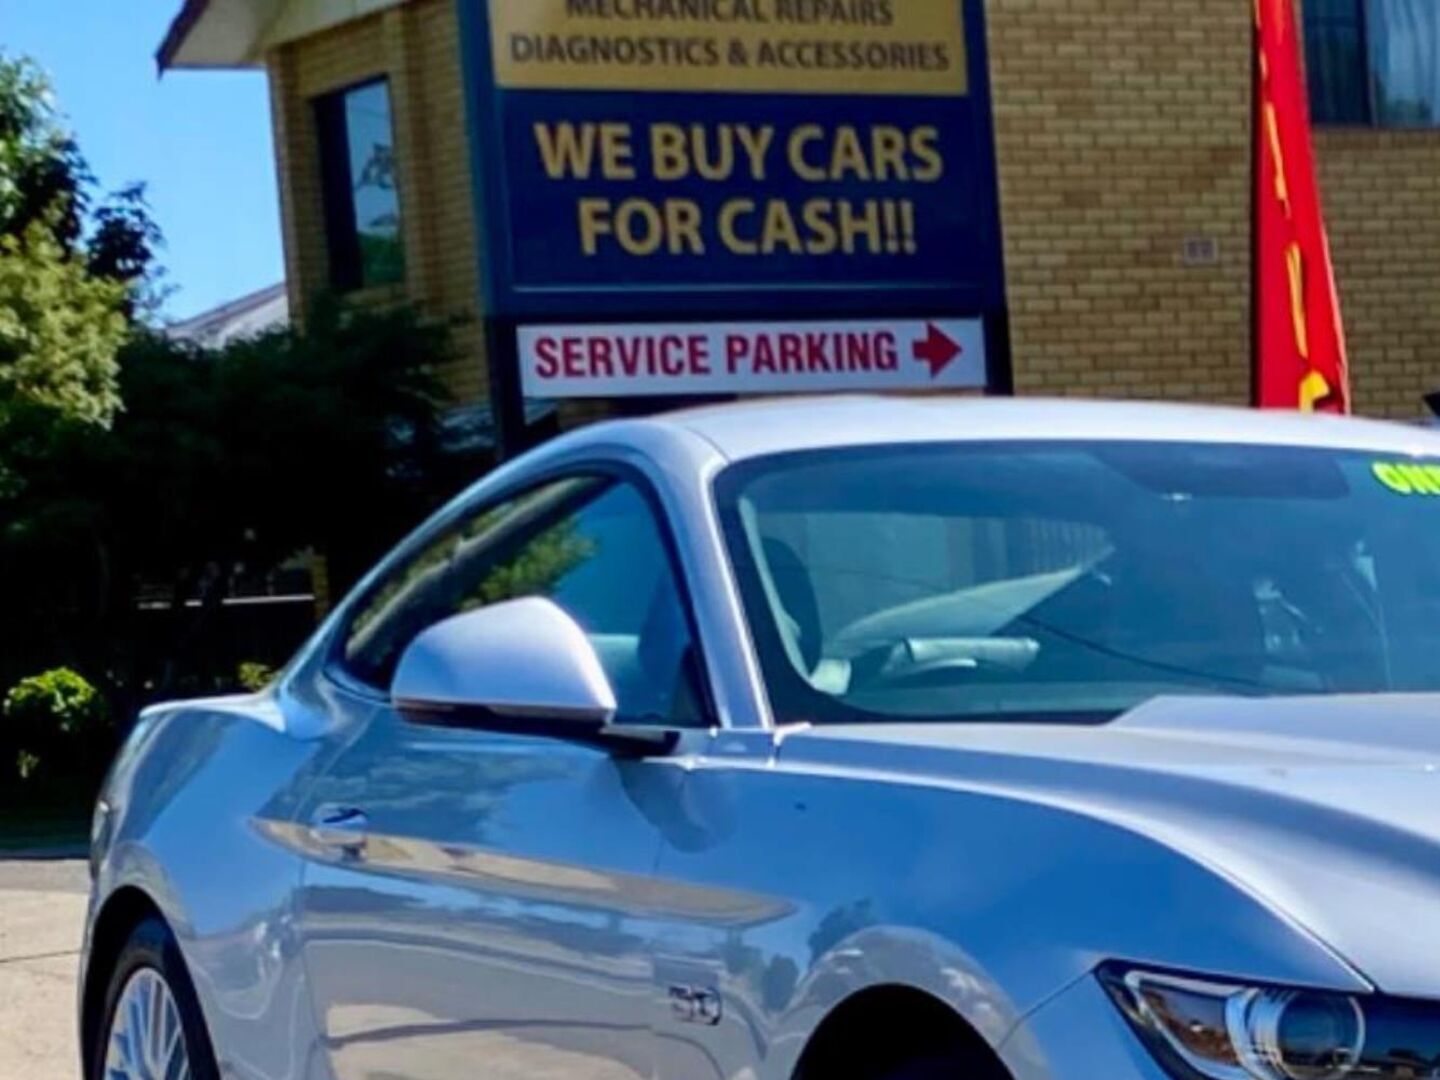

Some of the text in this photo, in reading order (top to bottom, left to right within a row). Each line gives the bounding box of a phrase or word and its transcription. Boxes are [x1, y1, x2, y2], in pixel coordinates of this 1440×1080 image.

[565, 0, 894, 27] MECHANICAL REPAIRS
[510, 33, 950, 72] DIAGNOSTICS & ACCESSORIES
[534, 123, 944, 182] WE BUY CARS
[579, 200, 917, 256] FOR CASH!!
[534, 331, 898, 379] SERVICE PARKING
